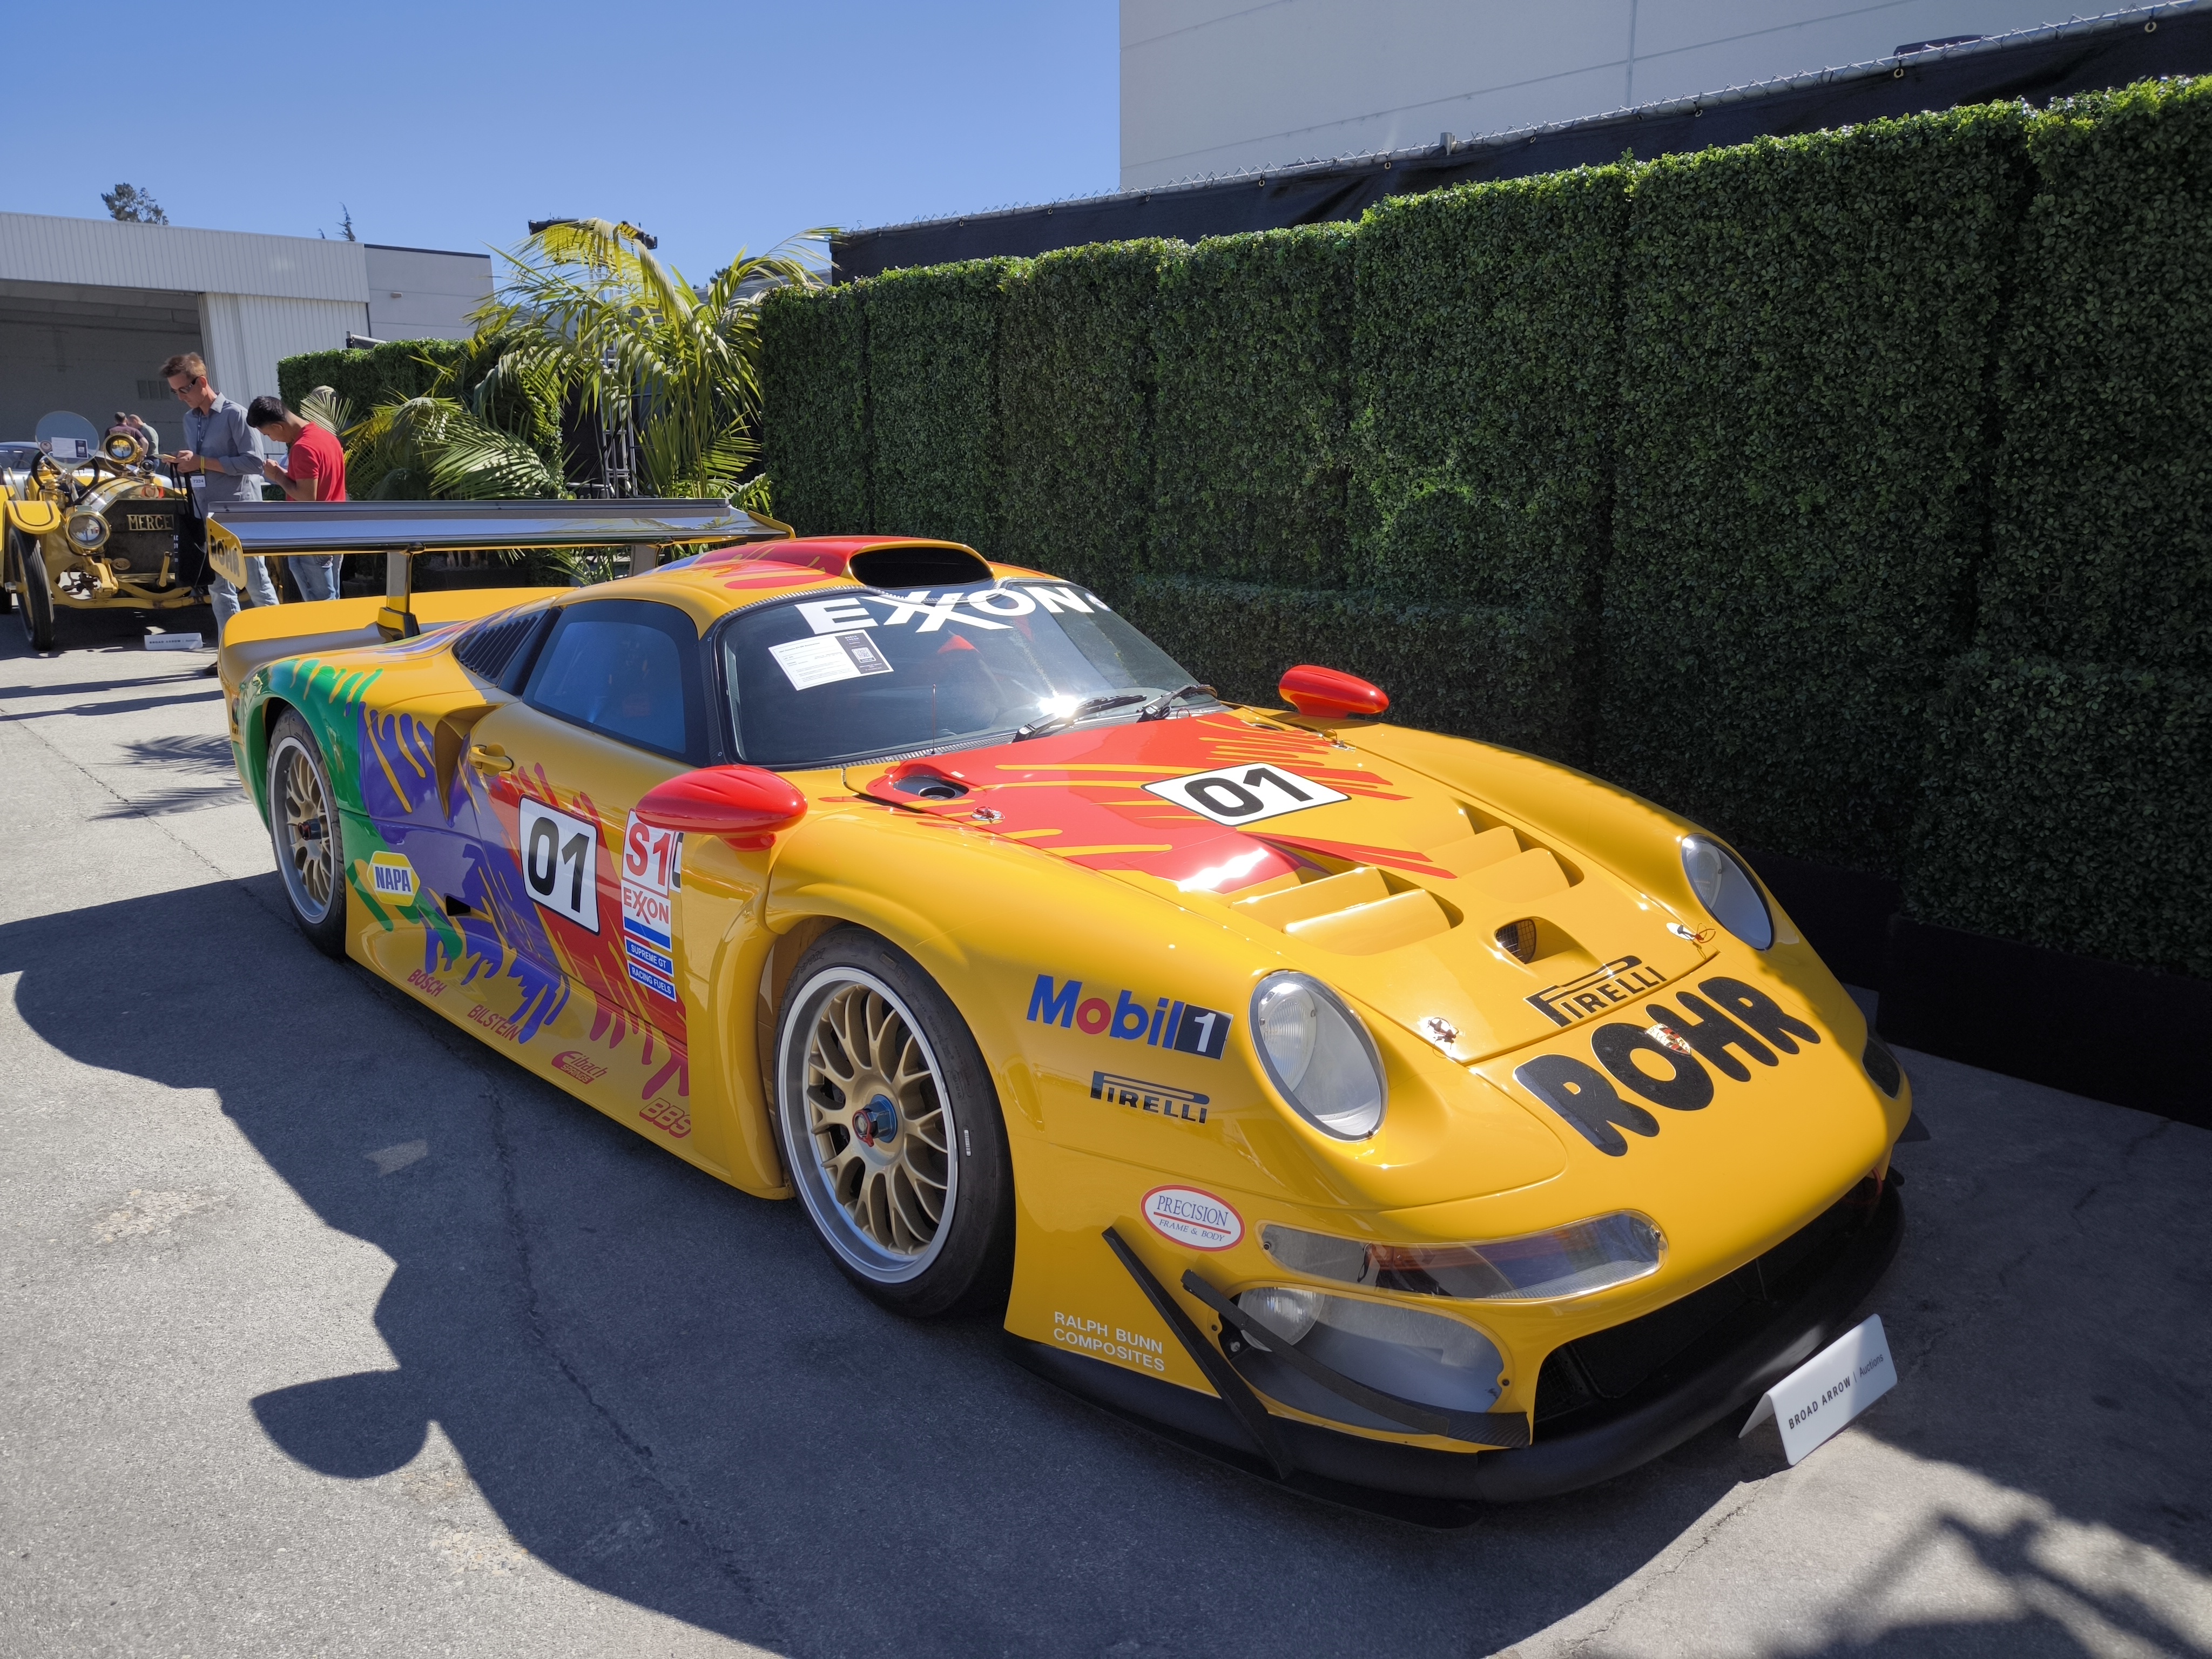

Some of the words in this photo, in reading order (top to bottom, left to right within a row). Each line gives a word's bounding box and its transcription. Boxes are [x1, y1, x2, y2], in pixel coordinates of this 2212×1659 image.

[127, 515, 174, 530] MERCE
[210, 535, 240, 577] ROHR
[793, 586, 1095, 635] EXXON
[1184, 767, 1314, 817] 01
[527, 816, 590, 913] 01
[626, 822, 671, 887] S1
[375, 866, 411, 893] NAPA
[623, 886, 669, 925] EXXON
[631, 944, 657, 965] SUPREME
[658, 957, 666, 969] GT
[407, 968, 448, 997] BOSCH
[632, 967, 653, 985] RACING
[653, 977, 671, 995] FUELS
[1523, 955, 1667, 1027] PIRELLI
[467, 1003, 523, 1041] BILSTEIN
[1027, 974, 1185, 1049] Mobil
[1194, 1012, 1217, 1053] 1
[551, 1050, 608, 1078] Eibach
[561, 1064, 591, 1083] SPRINGS
[1514, 976, 1821, 1157] ROHR
[639, 1097, 691, 1138] BBS
[1090, 1070, 1210, 1124] PIRELLI
[1156, 1195, 1229, 1227] PRECISION
[1159, 1219, 1188, 1235] FRAME
[1190, 1228, 1198, 1236] &
[1201, 1230, 1225, 1242] BODY
[1054, 1311, 1108, 1337] RALPH
[1116, 1327, 1163, 1354] BUNN
[1054, 1327, 1165, 1372] COMPOSITES
[1788, 1400, 1819, 1430] BROAD
[1822, 1375, 1851, 1406] ARROW
[1859, 1353, 1884, 1378] Auctions
